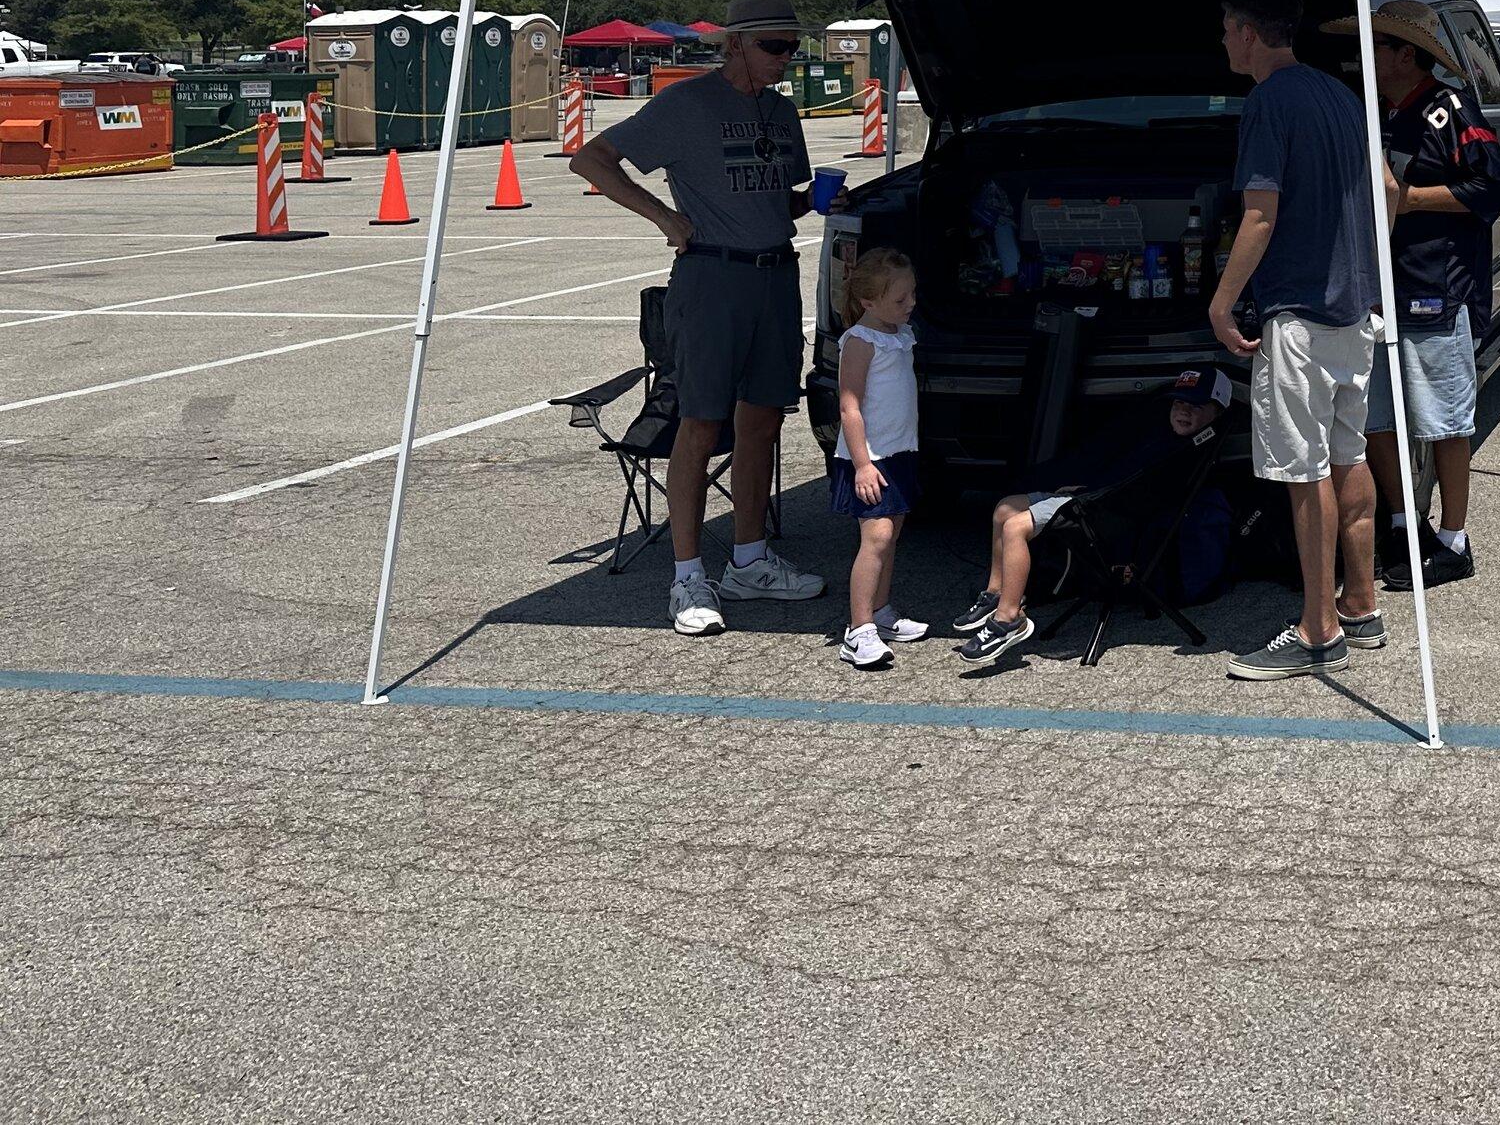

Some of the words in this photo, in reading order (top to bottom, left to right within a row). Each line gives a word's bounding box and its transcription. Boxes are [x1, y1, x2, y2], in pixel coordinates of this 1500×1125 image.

[208, 82, 228, 92] SOLO
[177, 92, 197, 101] ONLY
[203, 92, 234, 101] BASURA
[247, 98, 270, 108] TRASH
[276, 106, 302, 118] WM
[103, 111, 137, 125] WM
